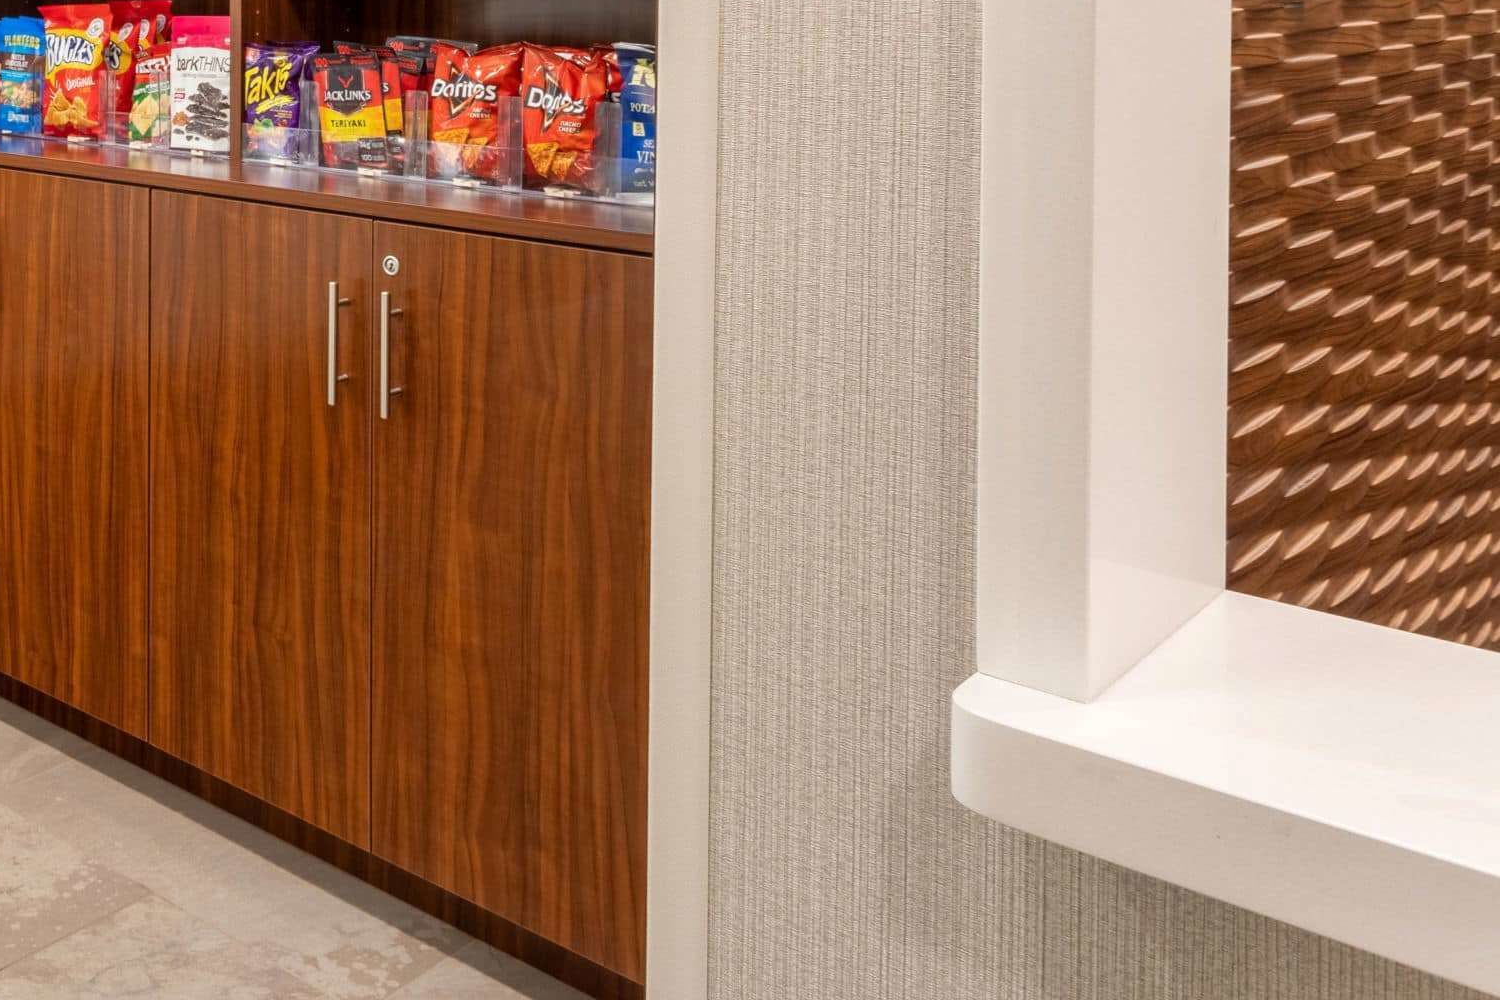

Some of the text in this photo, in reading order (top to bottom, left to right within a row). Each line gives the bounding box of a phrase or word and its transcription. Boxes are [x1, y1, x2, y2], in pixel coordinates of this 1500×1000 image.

[4, 34, 41, 50] PLANTERS
[45, 34, 95, 74] BUGLES
[244, 58, 293, 105] Takis
[431, 78, 497, 101] Doritos
[527, 86, 586, 115] Doritos
[330, 119, 367, 128] TERIYAKI
